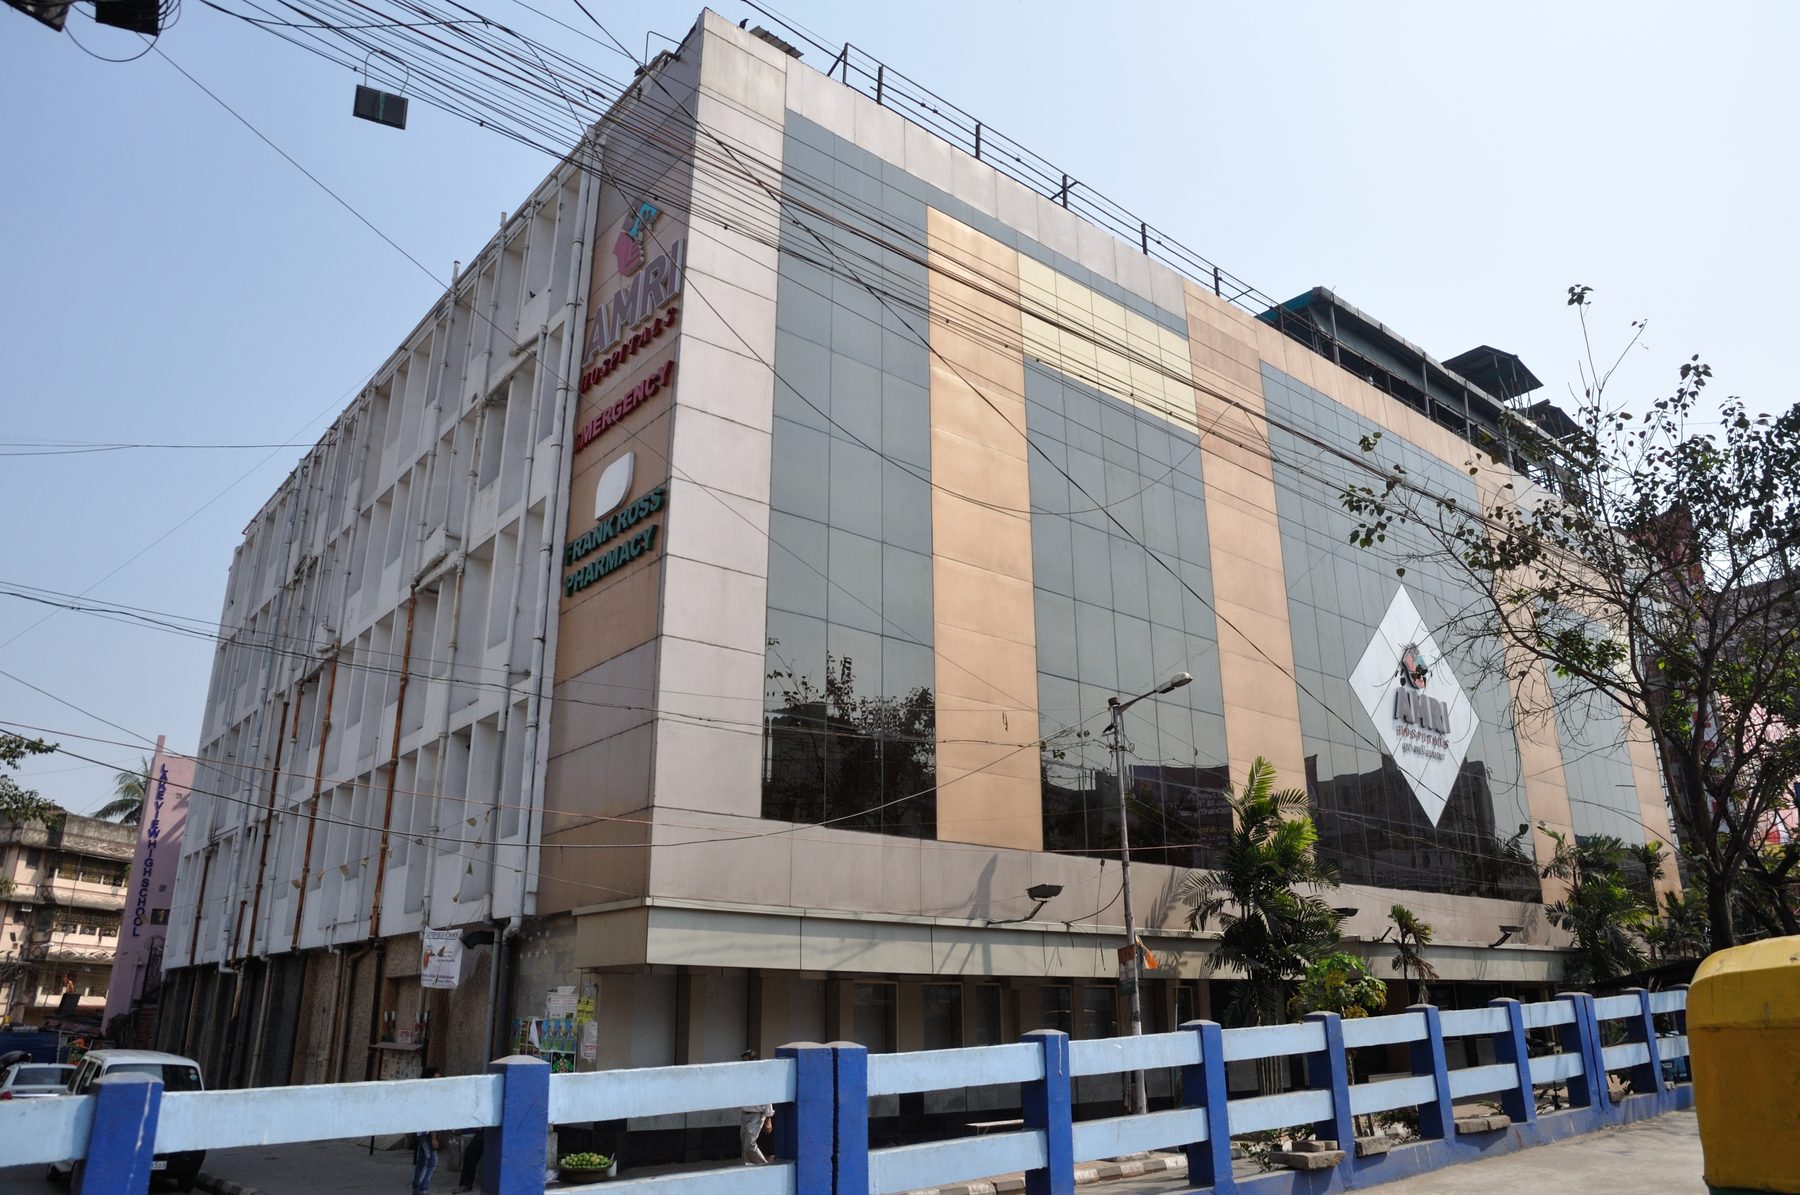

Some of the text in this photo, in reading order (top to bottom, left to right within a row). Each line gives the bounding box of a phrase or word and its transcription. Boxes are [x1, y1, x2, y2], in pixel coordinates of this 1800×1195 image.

[583, 239, 684, 368] AMRI
[579, 306, 678, 394] HOSPITALS
[616, 487, 666, 533] ROSS
[564, 524, 659, 598] PHARMACY
